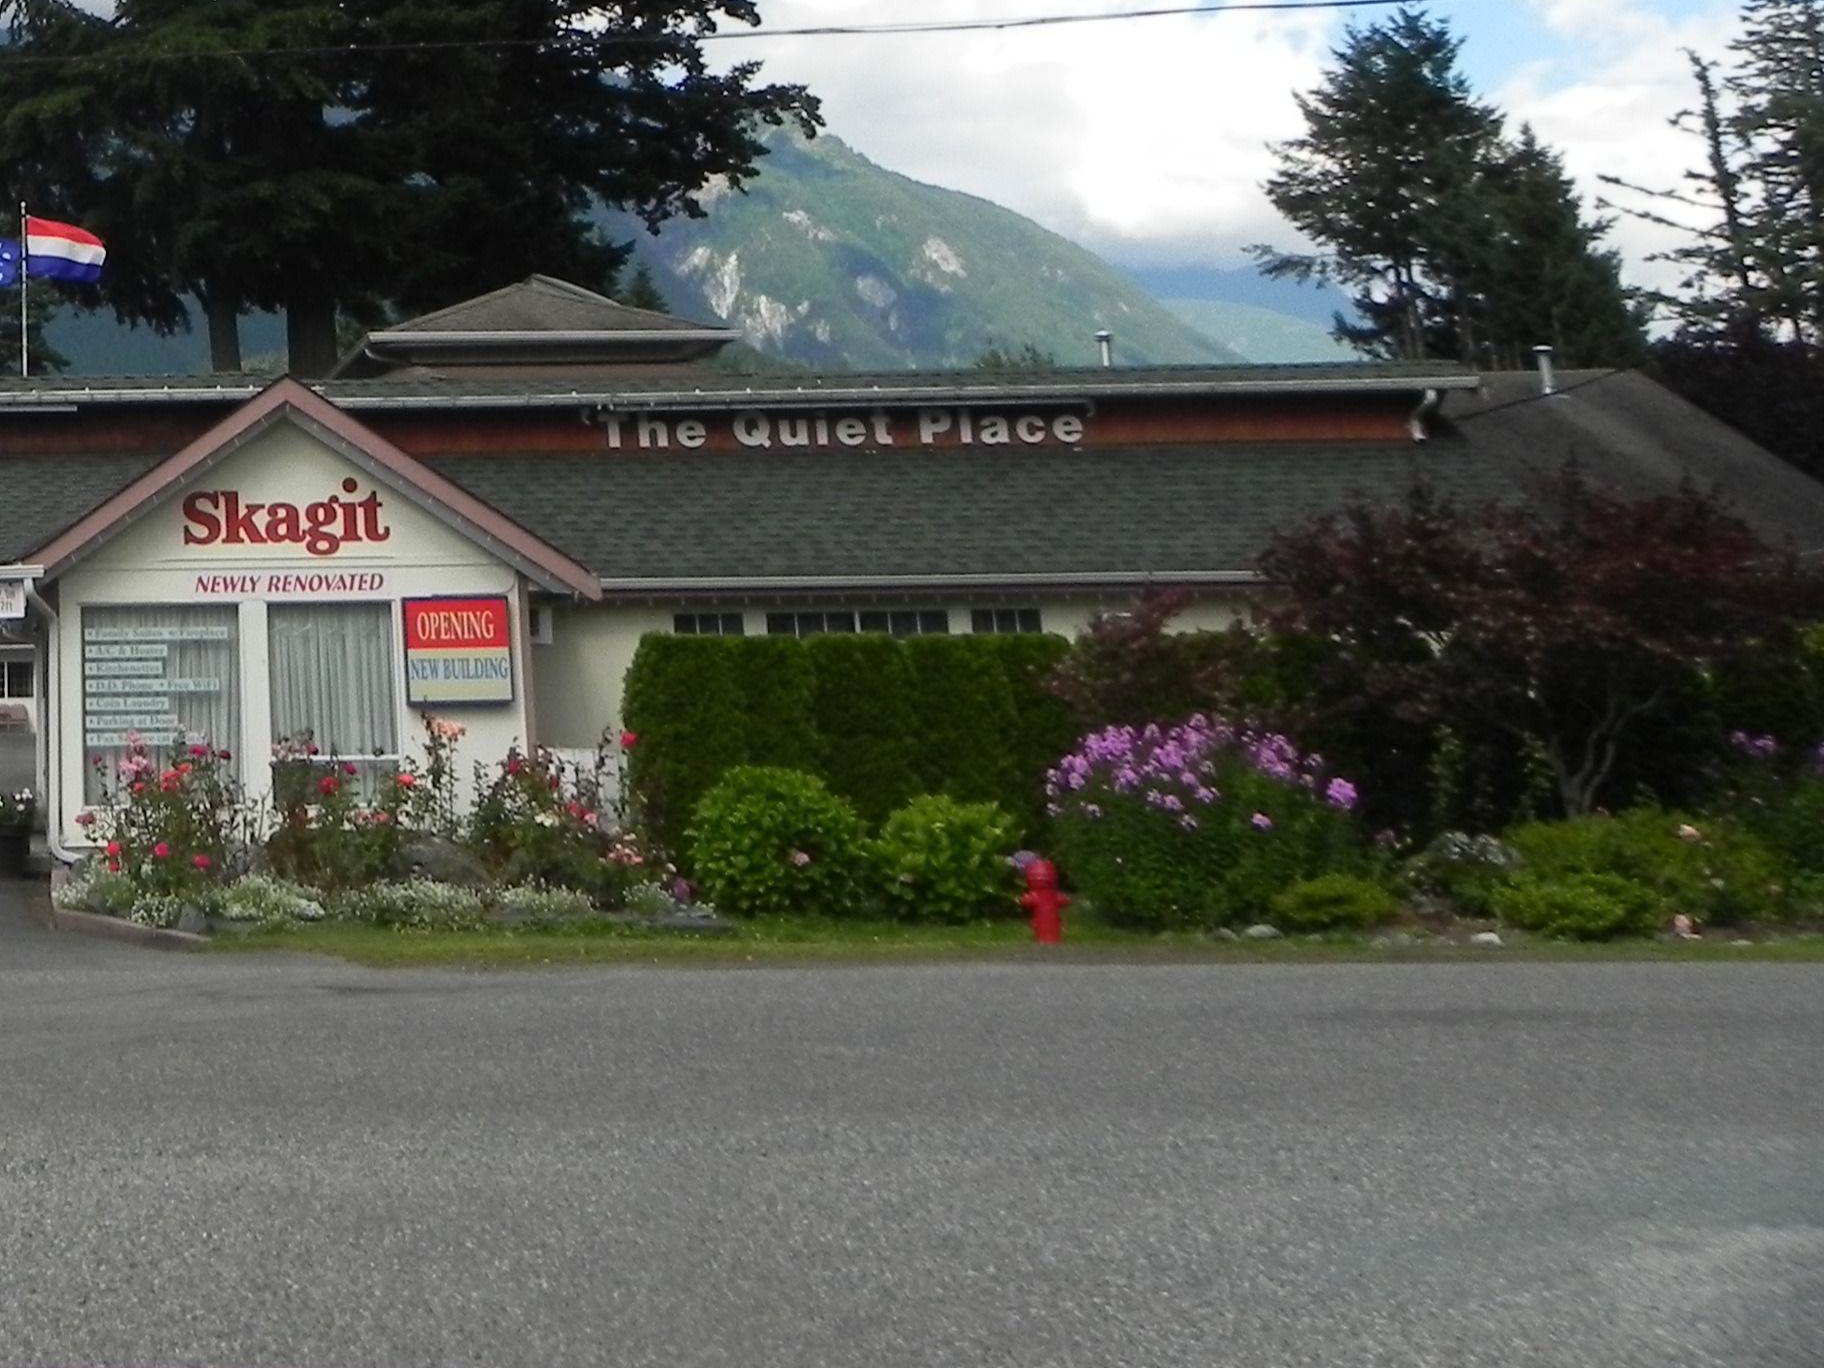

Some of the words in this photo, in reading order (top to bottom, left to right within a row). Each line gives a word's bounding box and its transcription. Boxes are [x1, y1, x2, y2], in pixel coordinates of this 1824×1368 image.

[597, 411, 708, 449] The
[732, 410, 893, 449] Quiet
[919, 408, 1085, 445] Place
[181, 477, 391, 557] Skagit
[195, 575, 261, 593] NEWLY
[266, 572, 385, 593] RENOVATED
[416, 609, 495, 641] OPENING
[410, 659, 440, 681] NEW
[442, 656, 509, 680] BUILDING
[124, 698, 166, 710] Laundry
